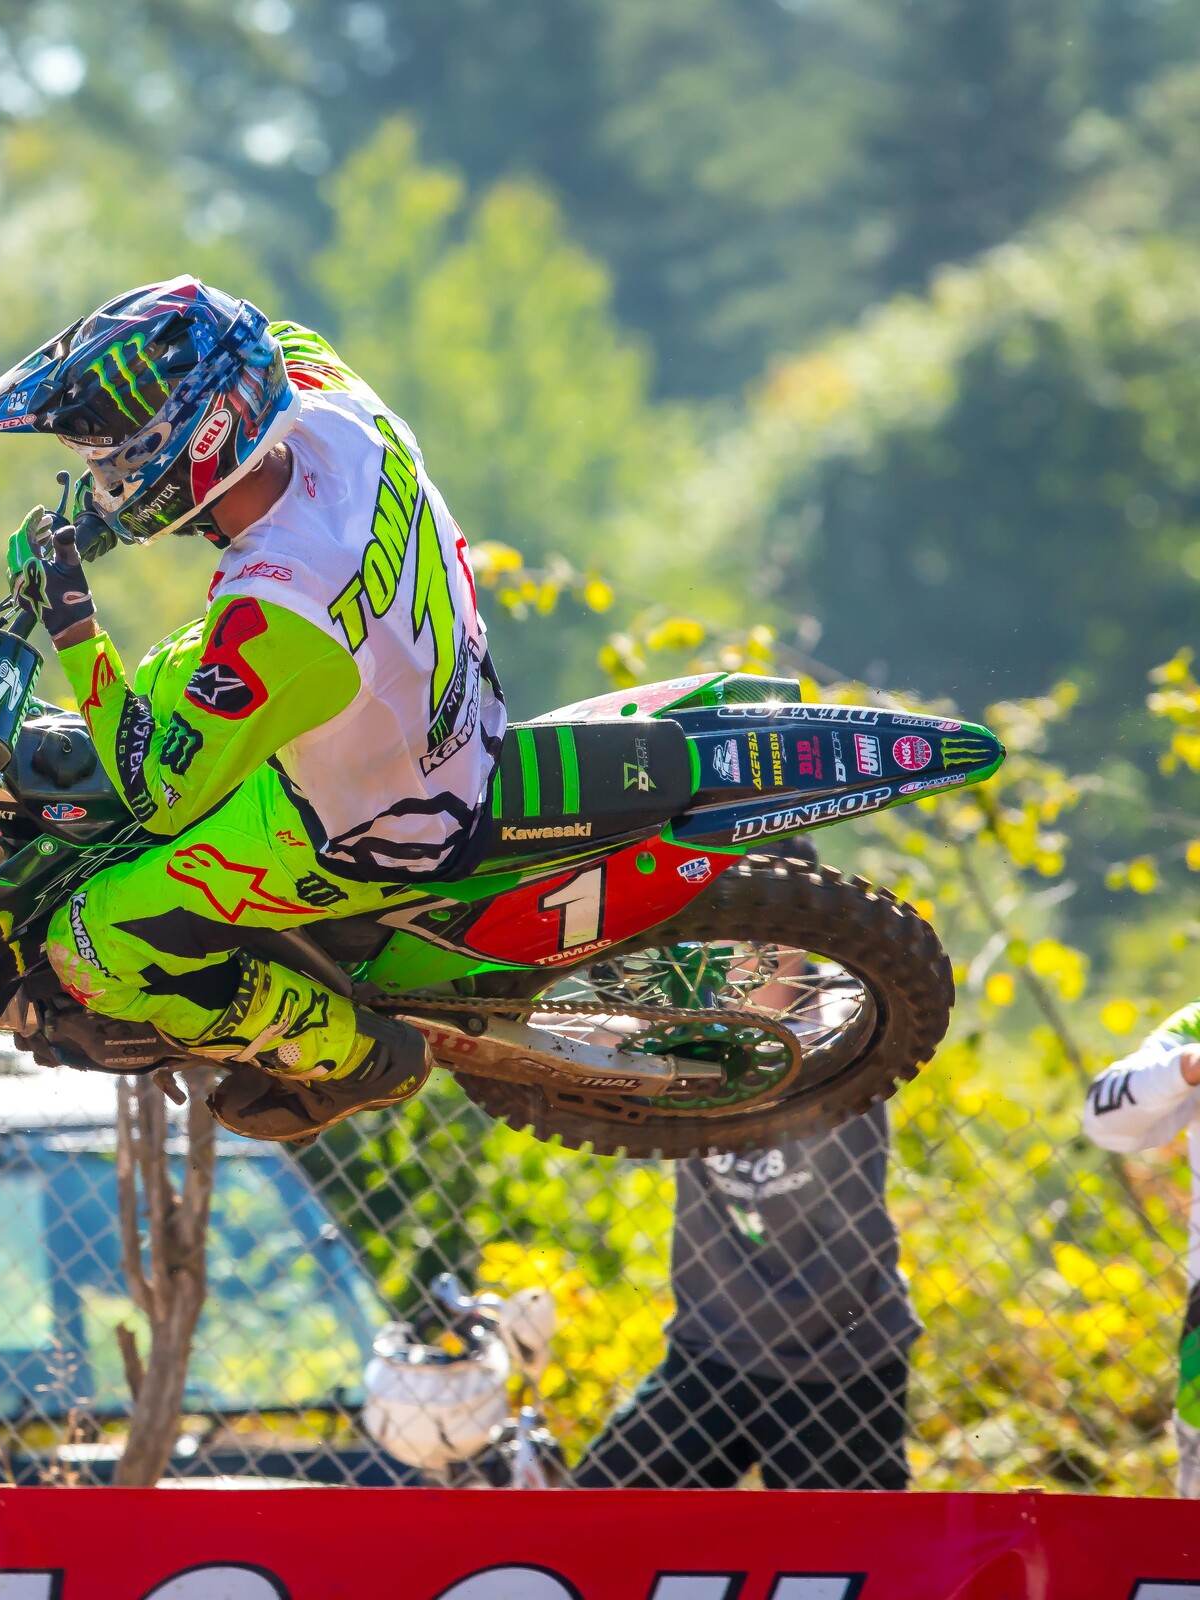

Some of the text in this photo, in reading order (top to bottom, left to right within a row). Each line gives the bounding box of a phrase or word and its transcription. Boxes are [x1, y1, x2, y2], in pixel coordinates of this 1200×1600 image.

[193, 418, 228, 456] BELL
[133, 482, 181, 524] MONSTER
[327, 414, 419, 653] TOMAC
[748, 731, 762, 791] ACERBIS
[769, 732, 784, 786] HINSON
[797, 740, 813, 775] DID
[902, 741, 913, 765] NGK
[43, 802, 75, 821] VP
[501, 822, 592, 841] Kawasaki
[731, 786, 892, 843] DUNLOP
[539, 861, 606, 951] 1
[534, 938, 612, 965] TOMAC
